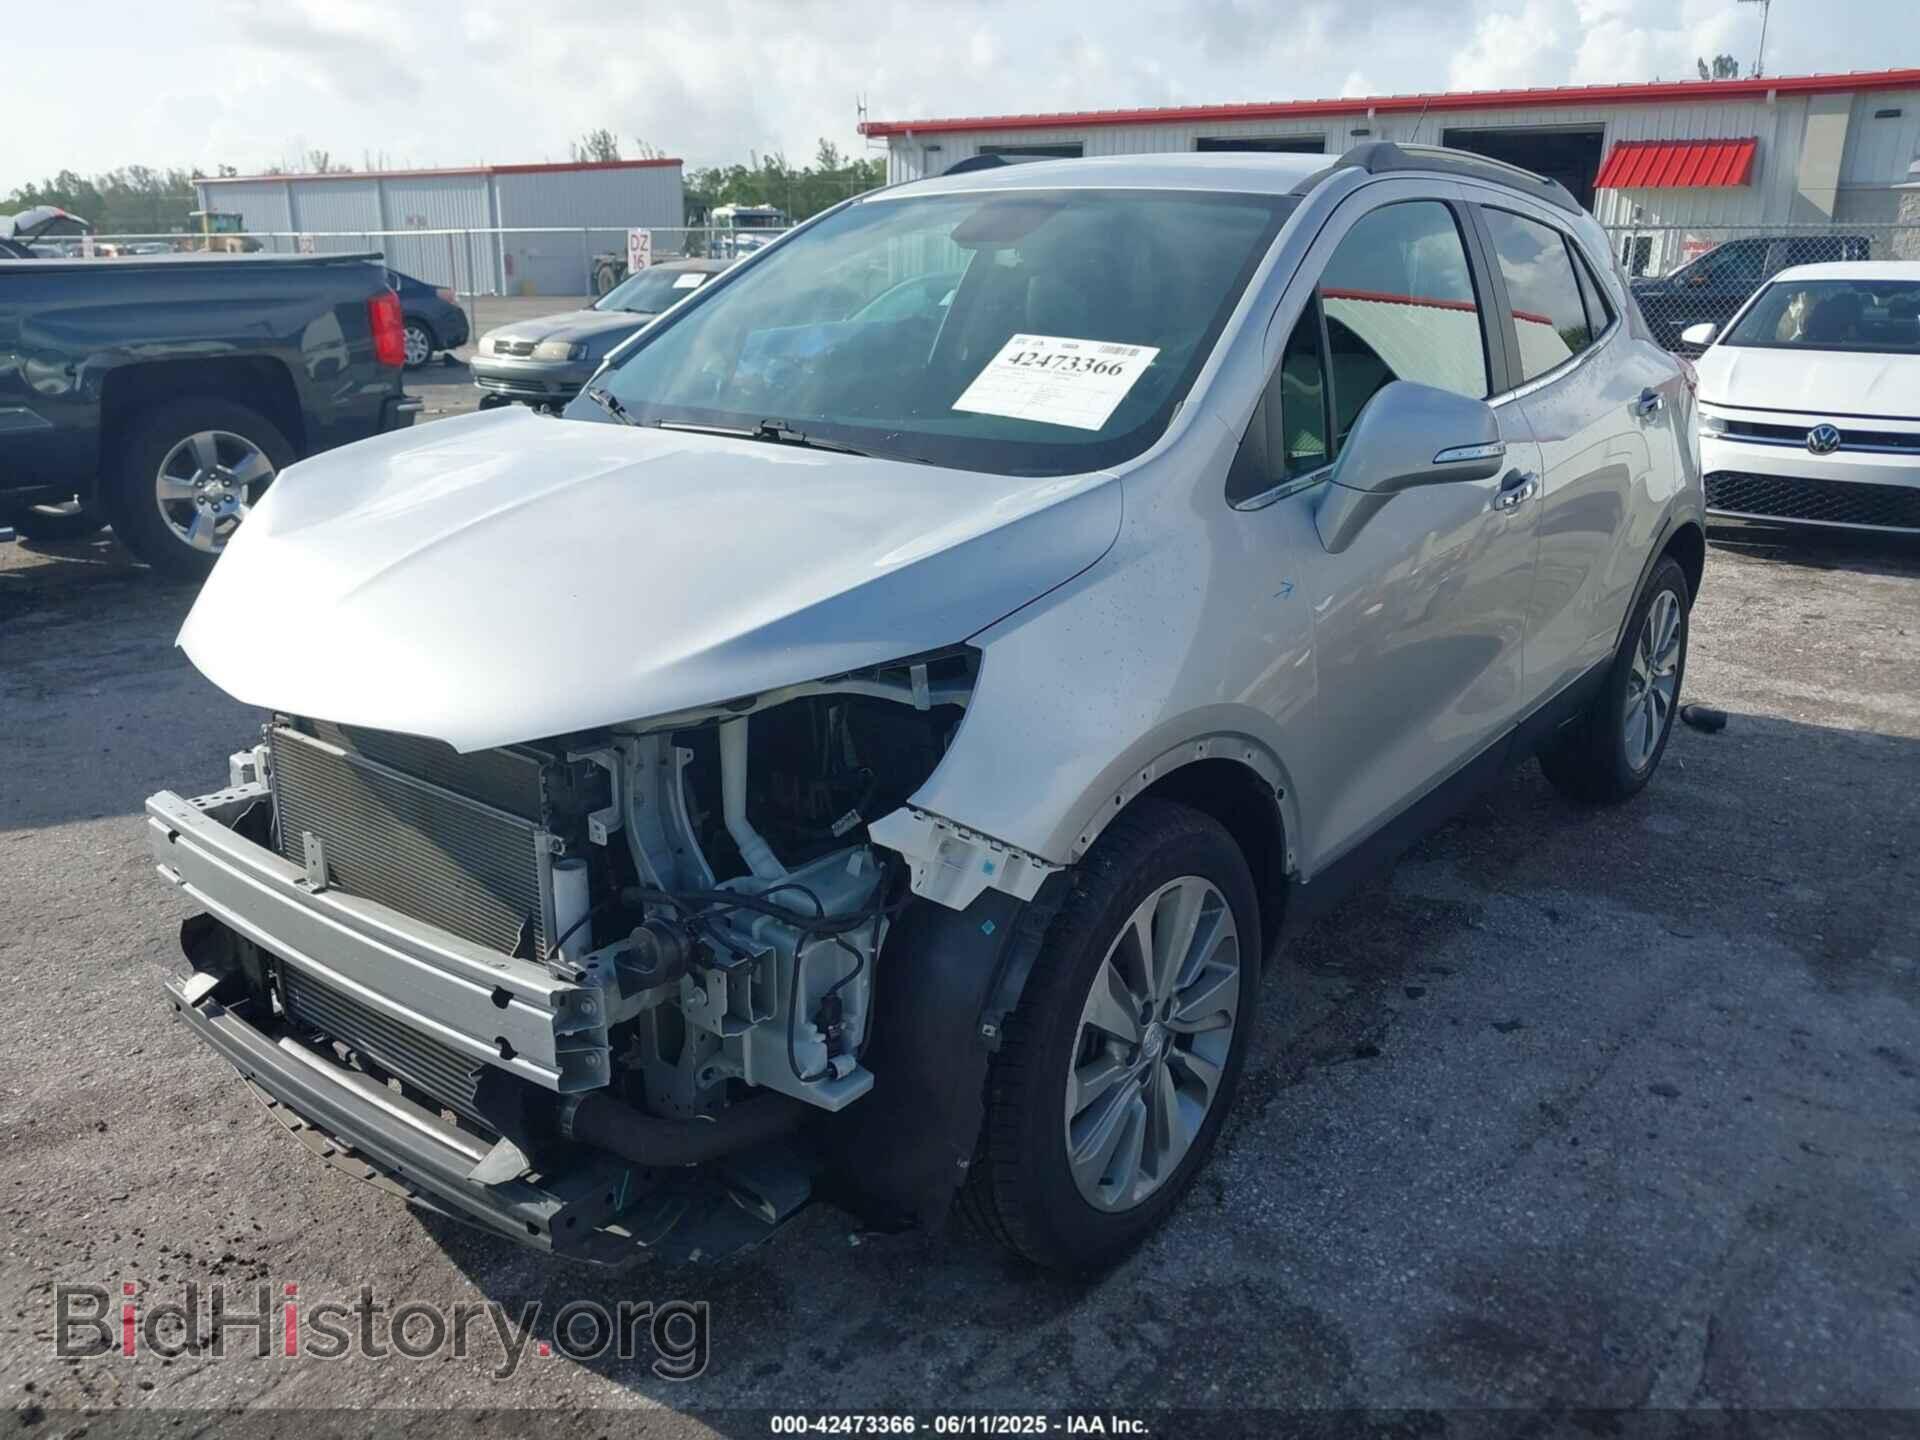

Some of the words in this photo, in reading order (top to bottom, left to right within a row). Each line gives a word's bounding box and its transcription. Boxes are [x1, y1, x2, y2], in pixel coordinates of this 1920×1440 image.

[631, 234, 649, 252] DZ
[633, 254, 646, 271] 16
[1008, 352, 1127, 376] 42473366
